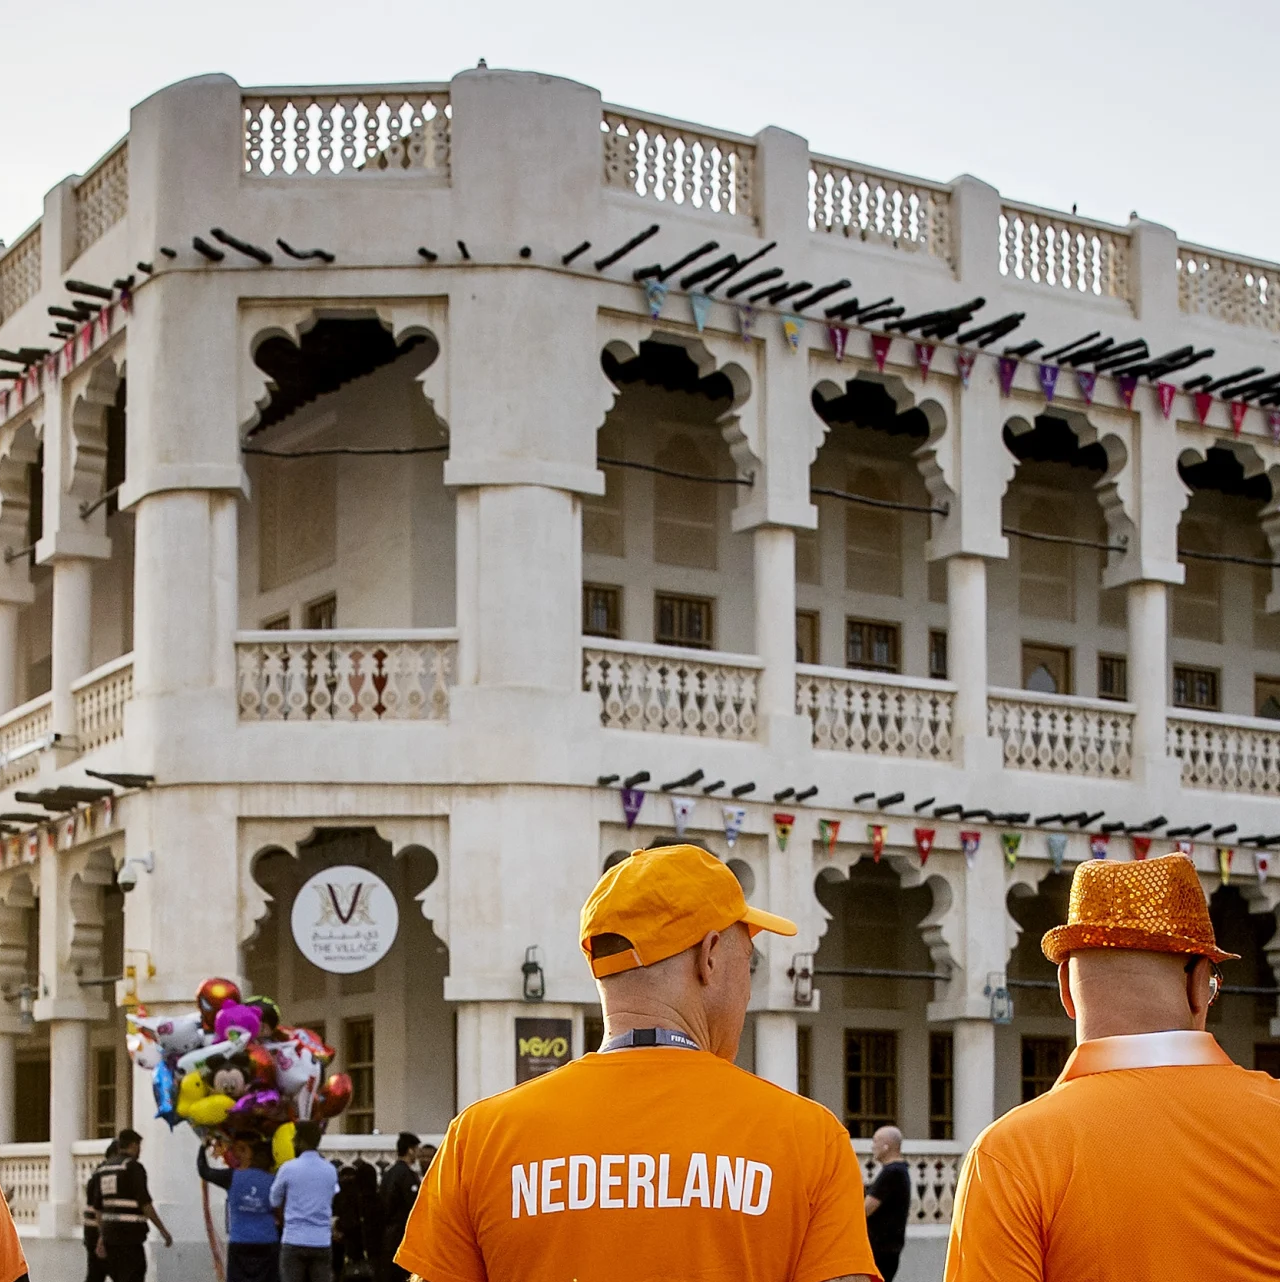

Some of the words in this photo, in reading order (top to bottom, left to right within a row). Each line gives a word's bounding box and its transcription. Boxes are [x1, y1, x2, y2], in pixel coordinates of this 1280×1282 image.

[312, 943, 331, 953] THE
[335, 942, 379, 953] VILLAGE
[511, 1152, 773, 1219] NEDERLAND
